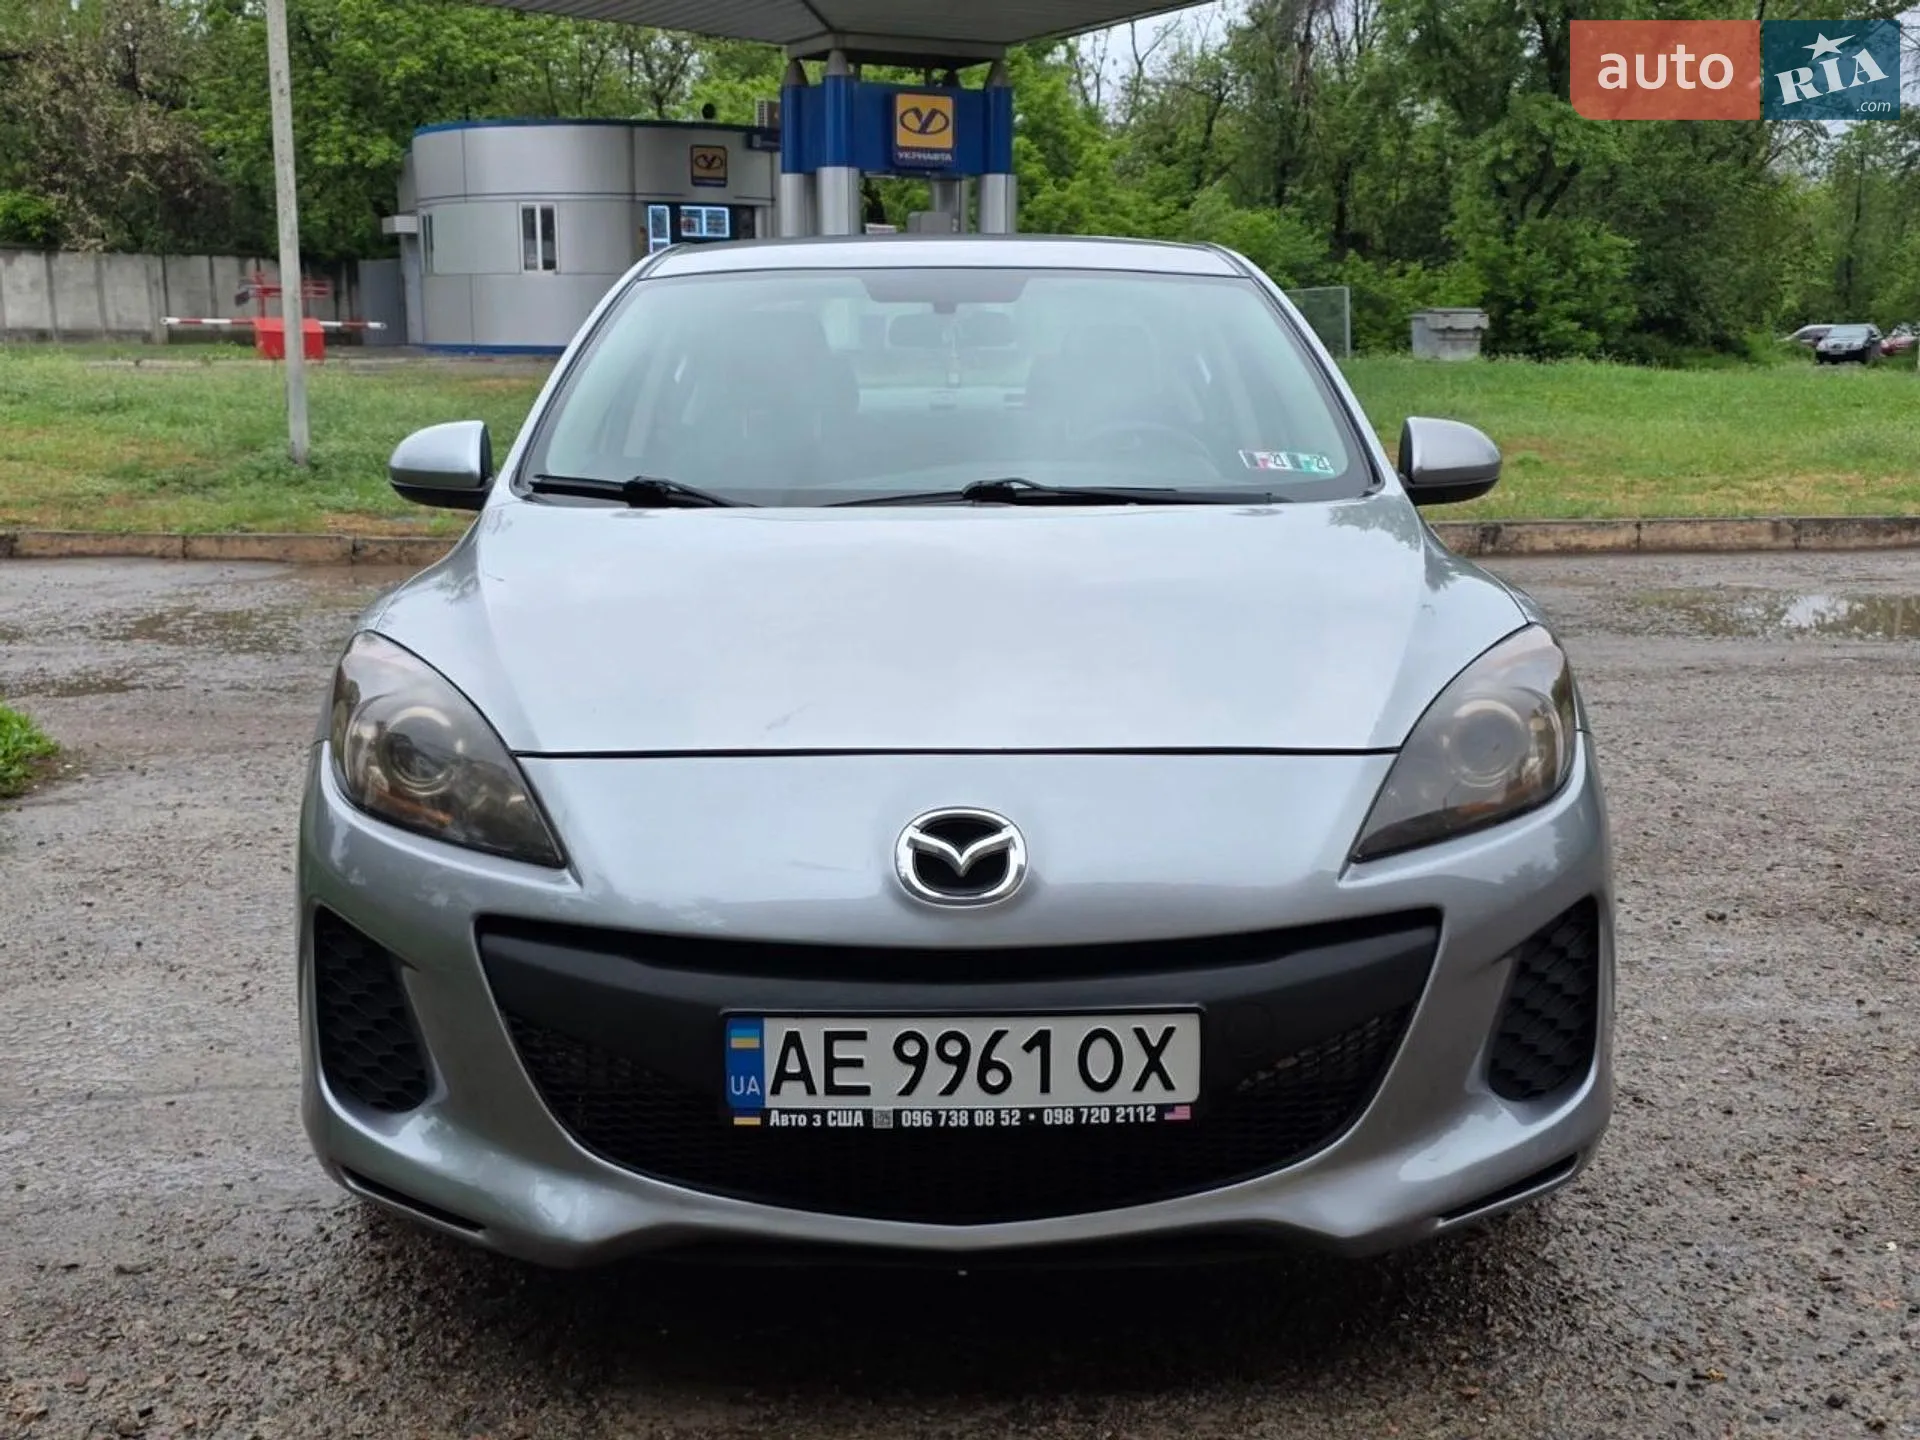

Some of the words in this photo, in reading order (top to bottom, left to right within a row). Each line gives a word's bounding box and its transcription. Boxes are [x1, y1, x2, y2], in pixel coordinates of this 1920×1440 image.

[769, 1030, 871, 1096] AE
[893, 1029, 1051, 1096] 9961
[1077, 1026, 1177, 1093] OX
[730, 1075, 761, 1096] UA
[769, 1110, 807, 1127] Авто
[827, 1109, 865, 1127] США
[901, 1110, 933, 1127] 096
[938, 1110, 969, 1127] 738
[974, 1109, 995, 1126] 08
[1000, 1109, 1021, 1126] 52
[1043, 1107, 1075, 1125] 098
[1080, 1106, 1110, 1124] 720
[1116, 1105, 1157, 1122] 2112
